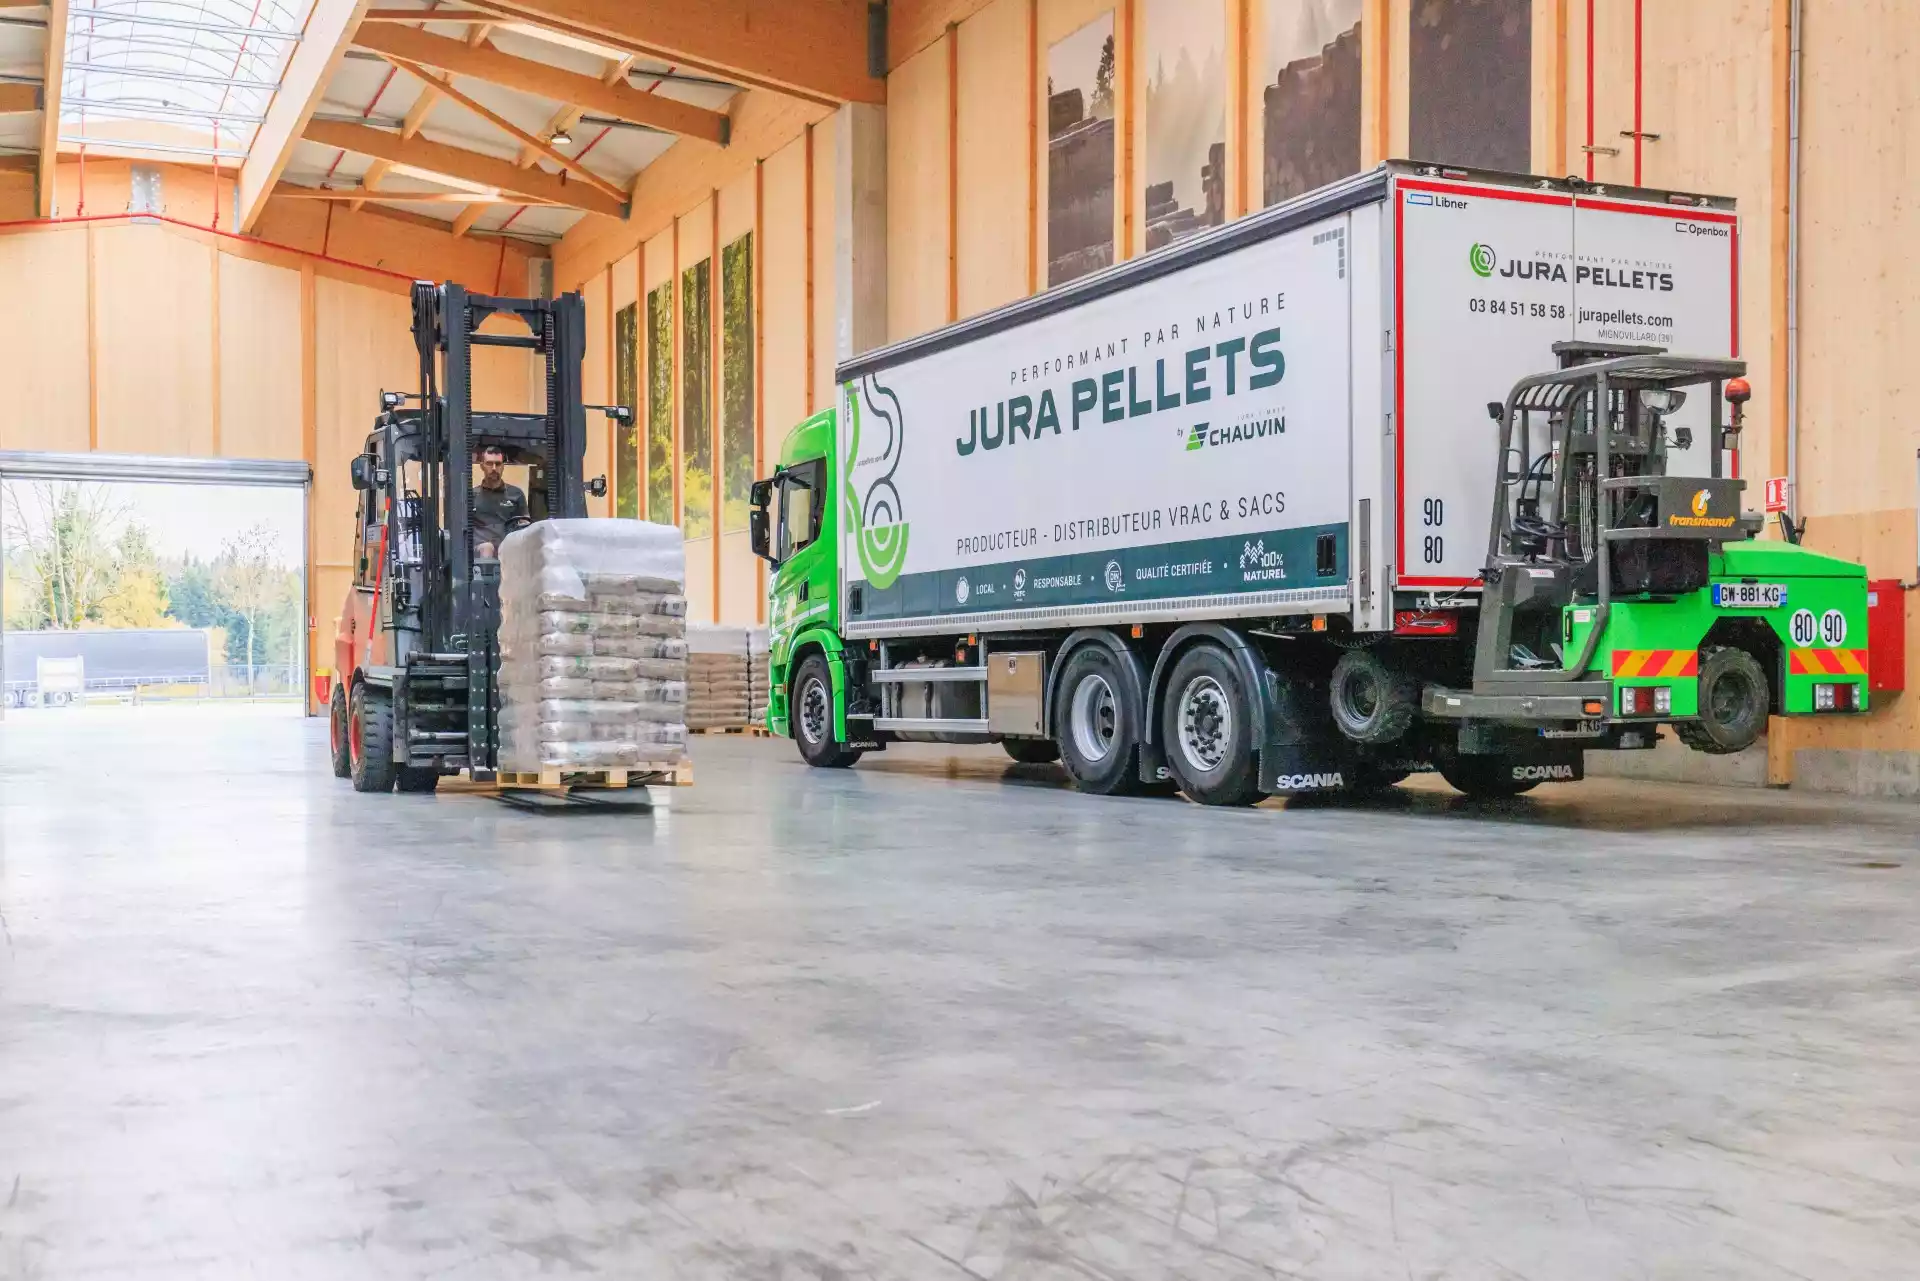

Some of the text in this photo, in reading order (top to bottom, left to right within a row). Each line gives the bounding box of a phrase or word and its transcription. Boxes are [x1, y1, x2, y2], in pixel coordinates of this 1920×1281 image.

[1435, 196, 1467, 209] Libner
[1688, 224, 1728, 237] Openbox
[1500, 260, 1673, 291] JURA PELLETS
[1470, 299, 1565, 319] 03 84 51 58 58
[1578, 307, 1673, 327] jurapellets.com
[1011, 292, 1285, 385] PERFORMANT PAR NATURE
[956, 327, 1285, 456] JURA PELLETS
[1176, 416, 1285, 446] by CHAUVIN
[1424, 498, 1443, 526] 90
[1669, 513, 1736, 527] transmanut
[957, 527, 1037, 556] PRODUCTEUR
[1054, 509, 1161, 542] DISTRIBUTEUR
[1168, 502, 1212, 526] VRAC
[1220, 500, 1230, 520] &
[1238, 492, 1285, 518] SACS
[1424, 535, 1443, 563] 80
[1261, 551, 1283, 568] 100%
[976, 559, 1212, 595] LOCAL RESPONSABLE QUALITÉ CERTIFIÉE
[1244, 568, 1286, 581] NATUREL
[1721, 587, 1779, 602] GW-881-KG
[1795, 613, 1842, 642] 80 90
[1276, 773, 1343, 789] SCANIA
[1512, 765, 1574, 779] SCANIA
